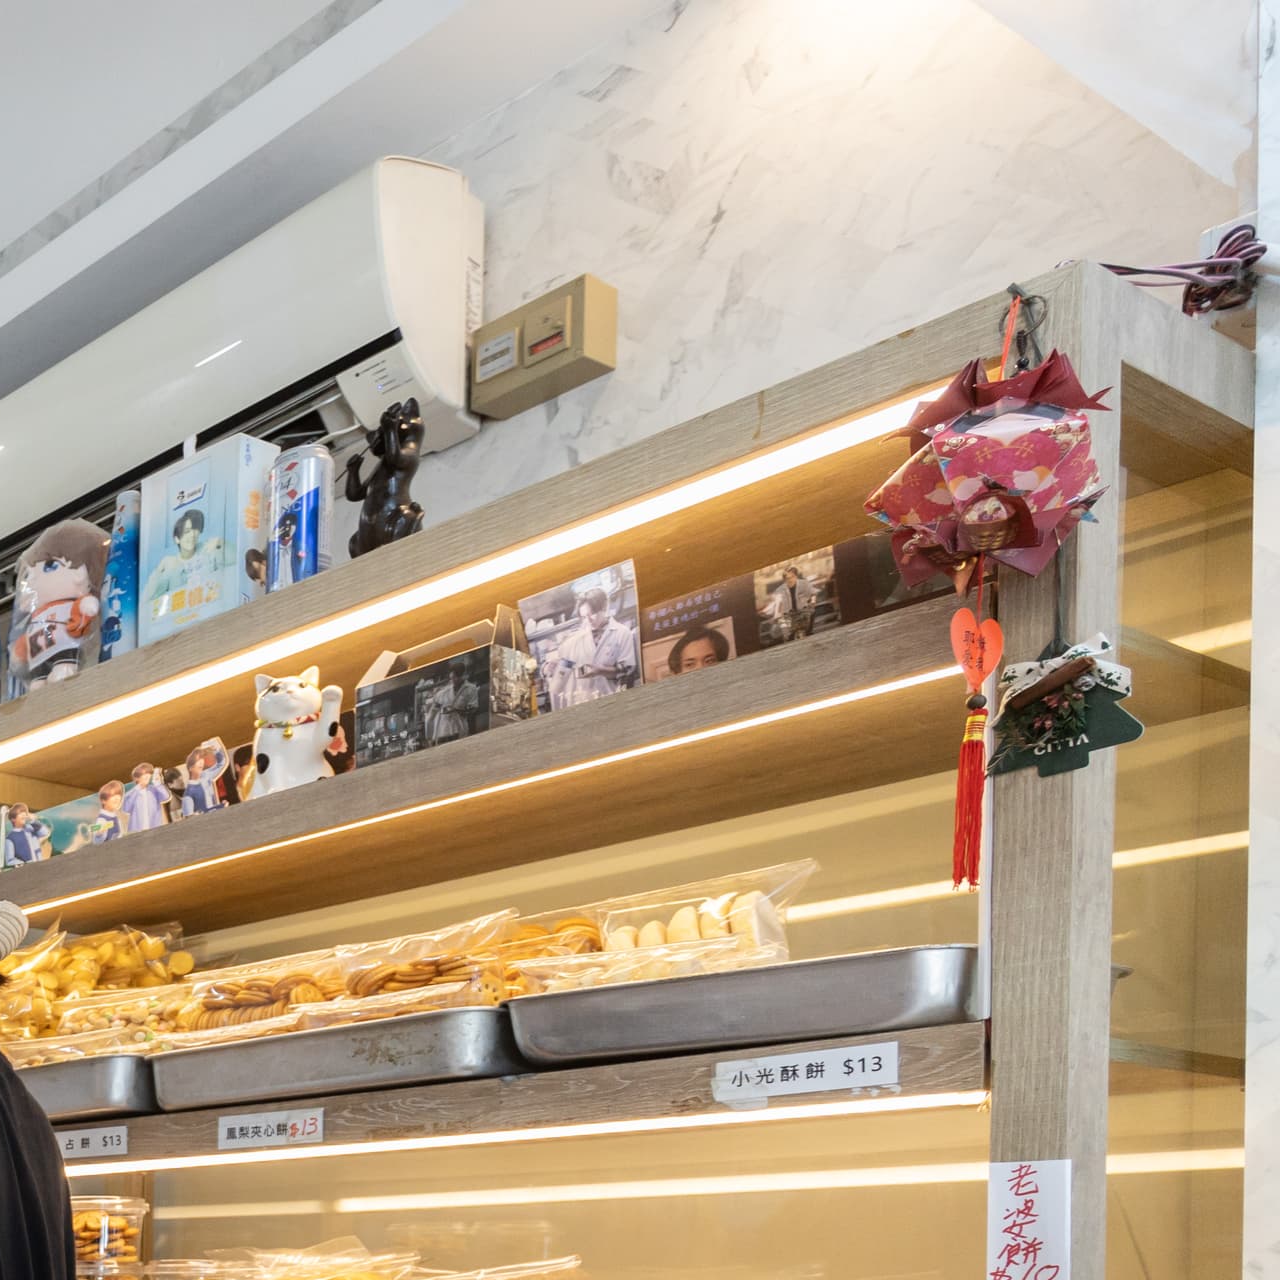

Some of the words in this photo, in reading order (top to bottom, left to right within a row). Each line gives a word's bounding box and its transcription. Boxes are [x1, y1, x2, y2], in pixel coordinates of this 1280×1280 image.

[731, 1061, 825, 1087] 小光酥餅
[843, 1055, 883, 1077] $13
[289, 1116, 319, 1139] $13
[101, 1134, 122, 1149] $13
